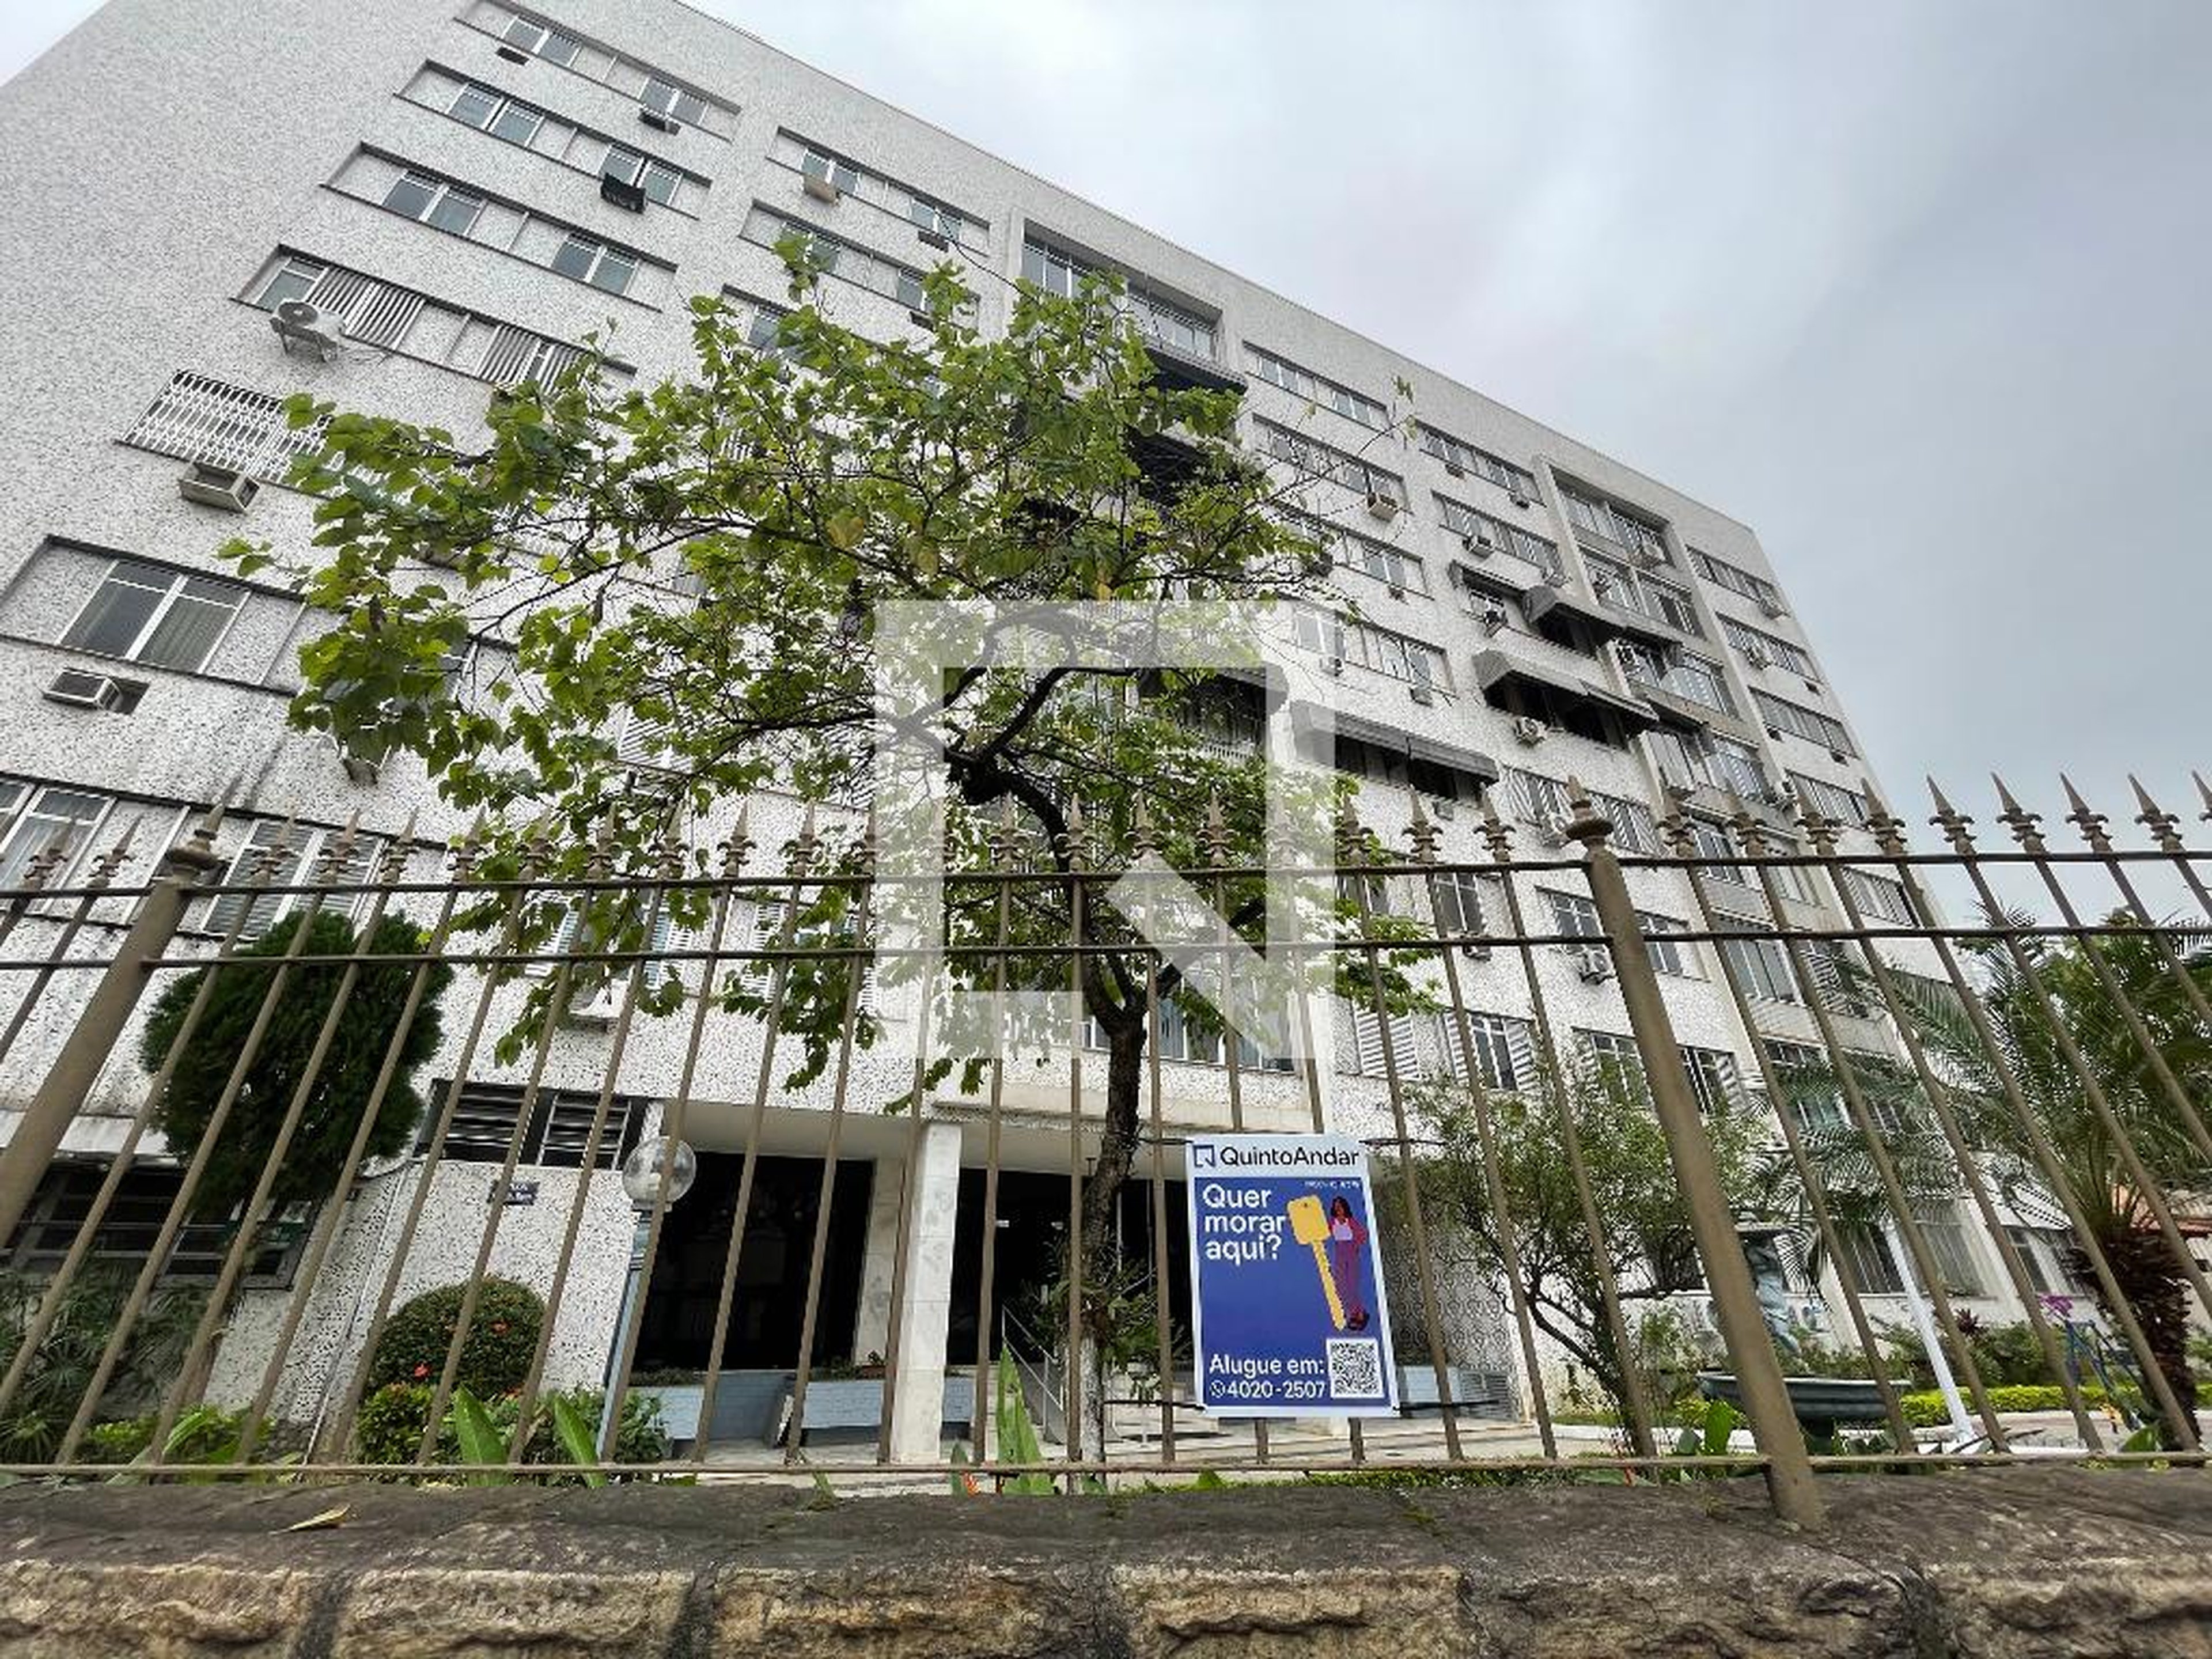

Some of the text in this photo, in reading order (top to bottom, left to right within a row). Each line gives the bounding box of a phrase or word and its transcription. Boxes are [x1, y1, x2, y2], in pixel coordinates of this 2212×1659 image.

[1219, 1146, 1359, 1165] QuintoAndar
[1203, 1183, 1272, 1208] Quer
[1205, 1215, 1286, 1234] morar
[1205, 1233, 1282, 1266] aqui?
[1210, 1354, 1324, 1379] Alugue em:
